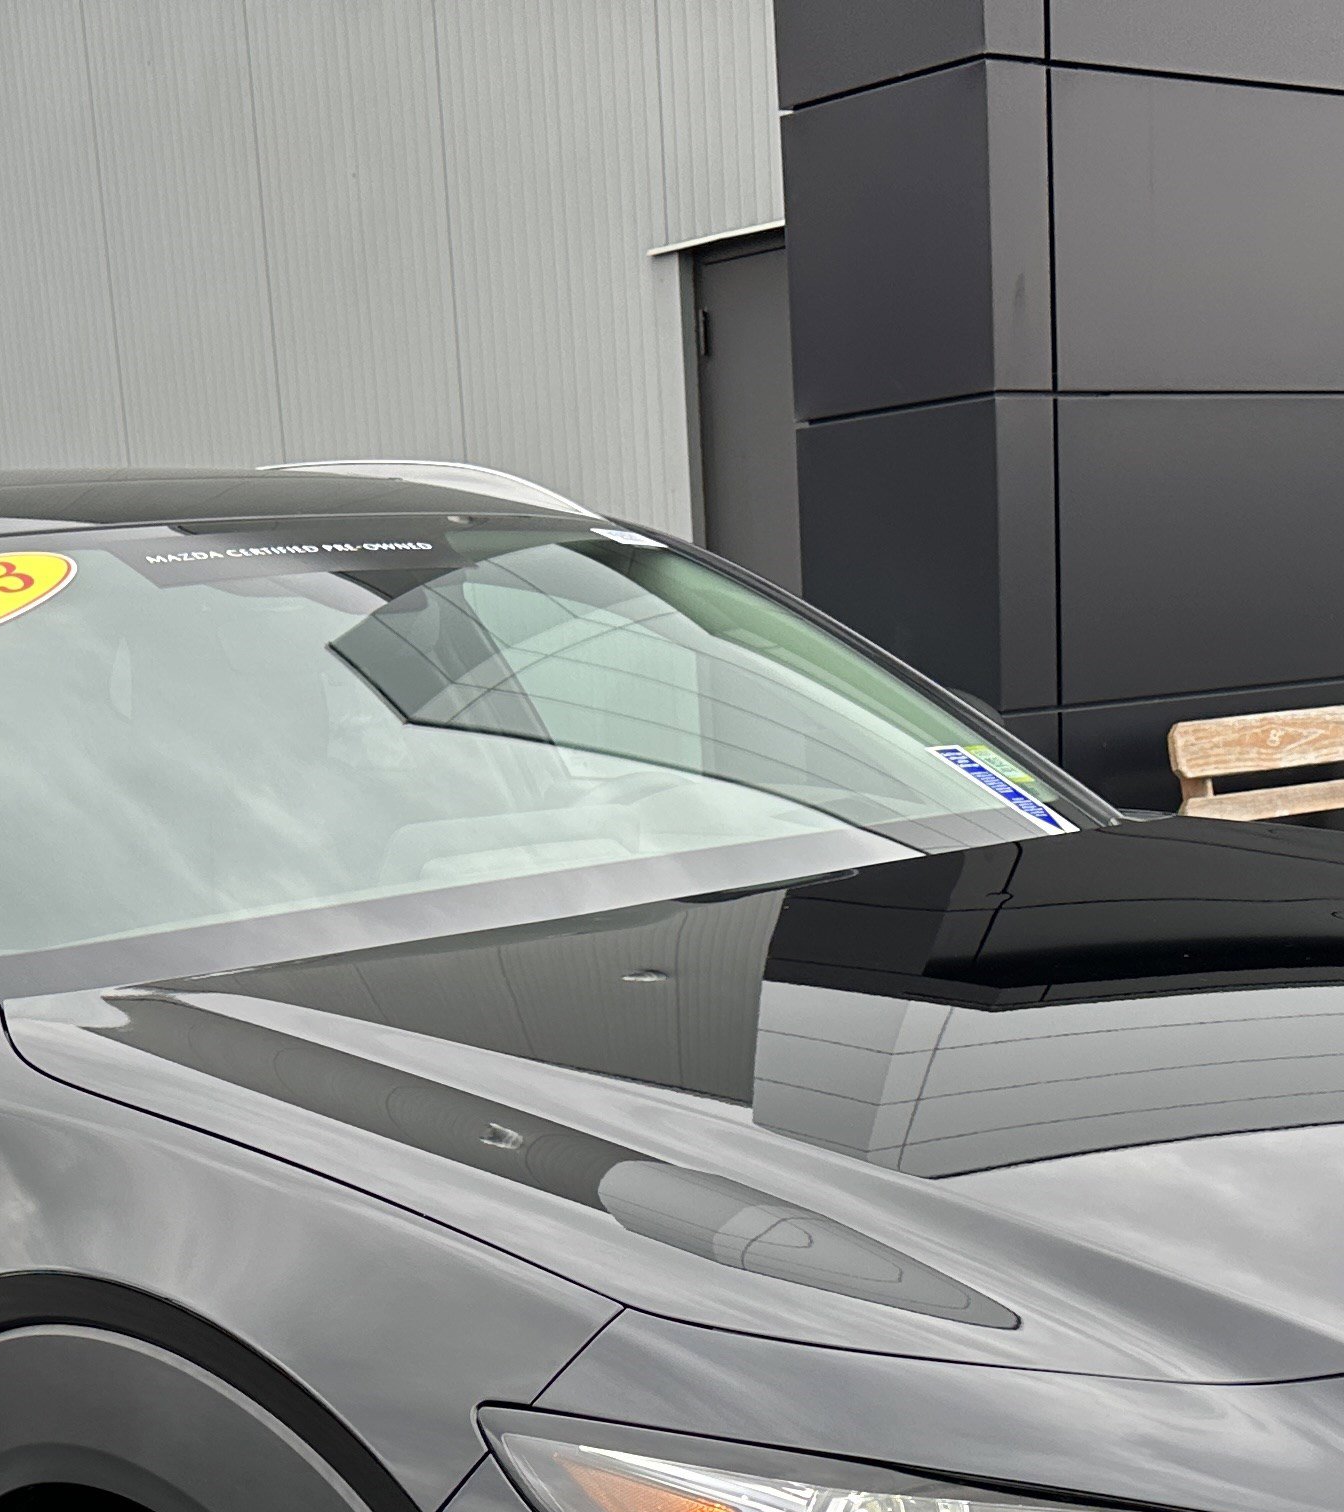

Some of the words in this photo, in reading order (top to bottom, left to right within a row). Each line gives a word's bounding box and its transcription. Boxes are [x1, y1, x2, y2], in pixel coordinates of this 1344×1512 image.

[145, 551, 224, 565] MAZDA
[226, 545, 319, 558] CERTIFIED
[322, 542, 433, 553] PRE-OWNED
